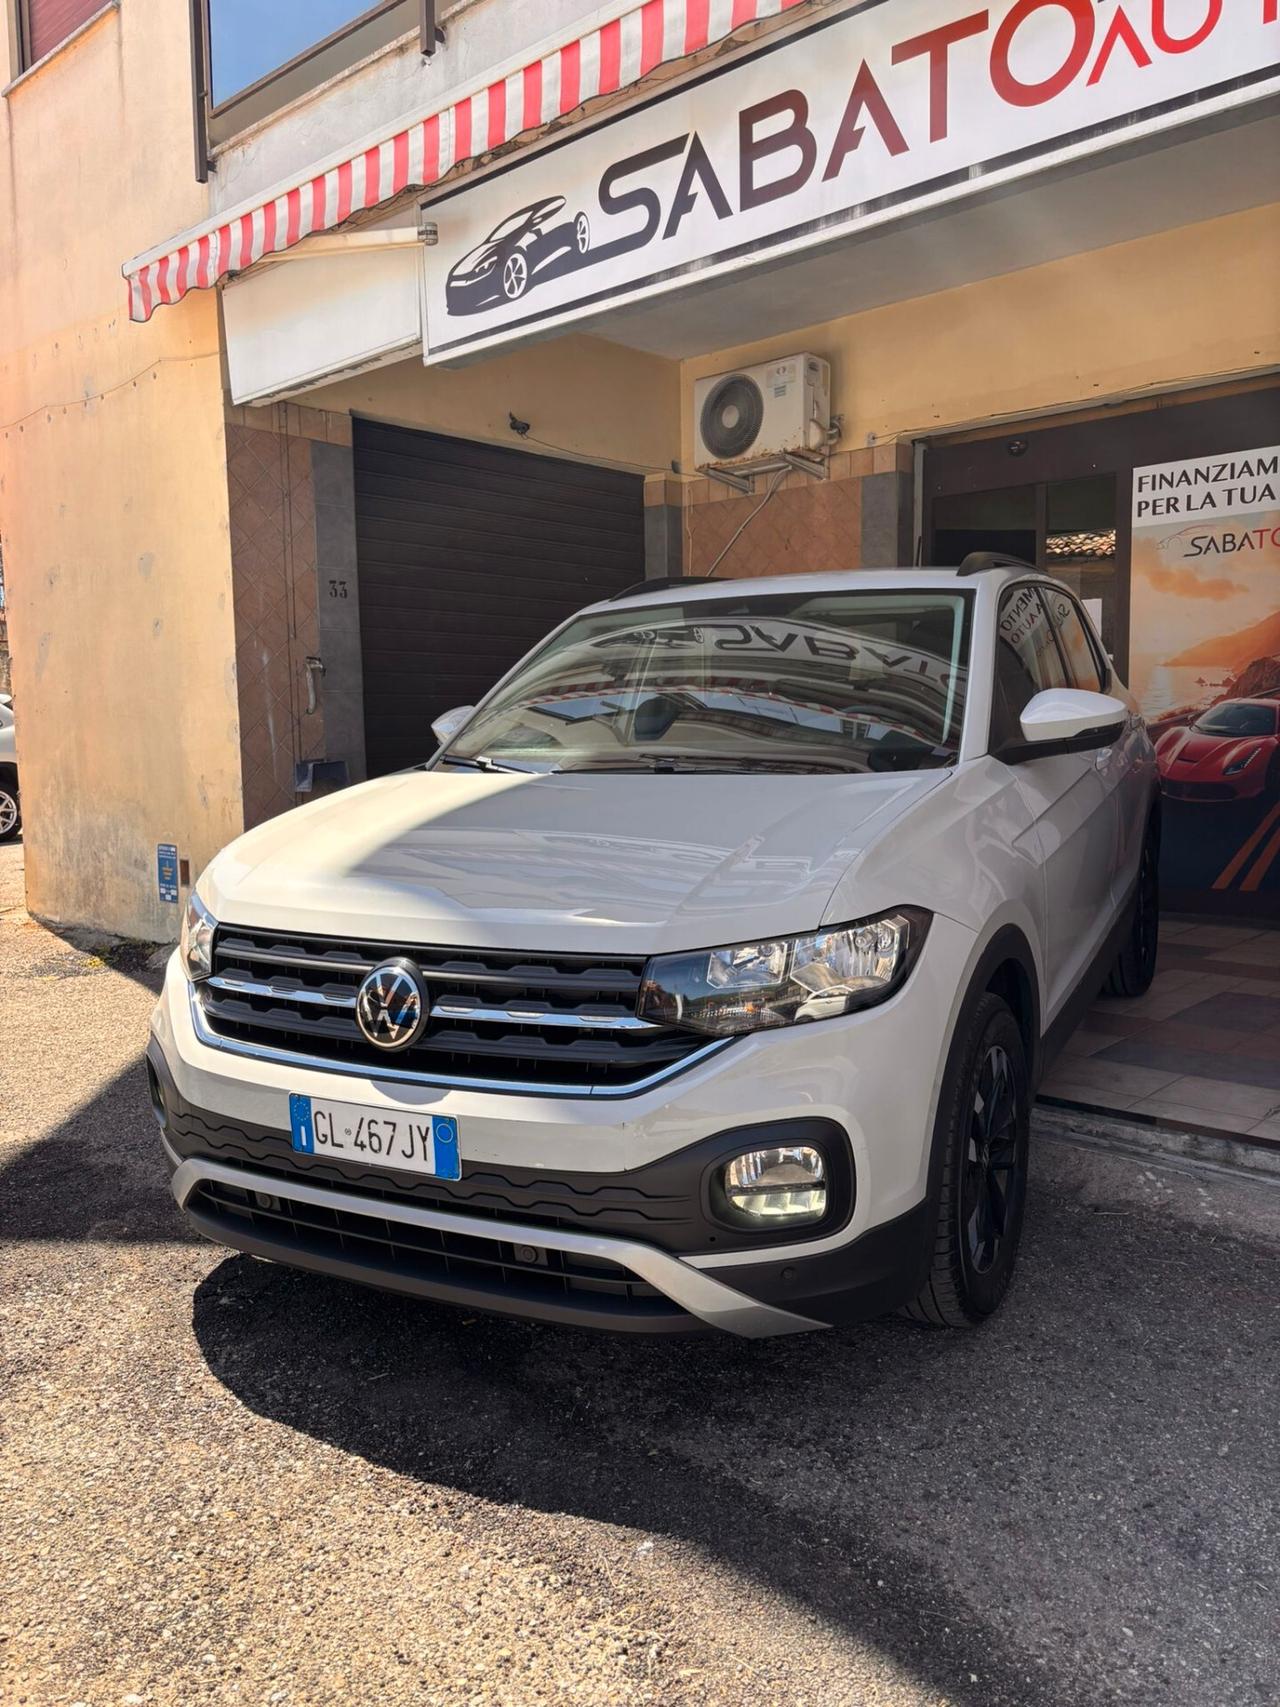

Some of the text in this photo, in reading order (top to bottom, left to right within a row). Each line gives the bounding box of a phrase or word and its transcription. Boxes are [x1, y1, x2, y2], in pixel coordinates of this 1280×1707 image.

[1137, 456, 1279, 493] FINANZIAM
[1137, 483, 1277, 518] PER LA TUA
[329, 580, 348, 599] 33
[313, 1110, 345, 1149] GL
